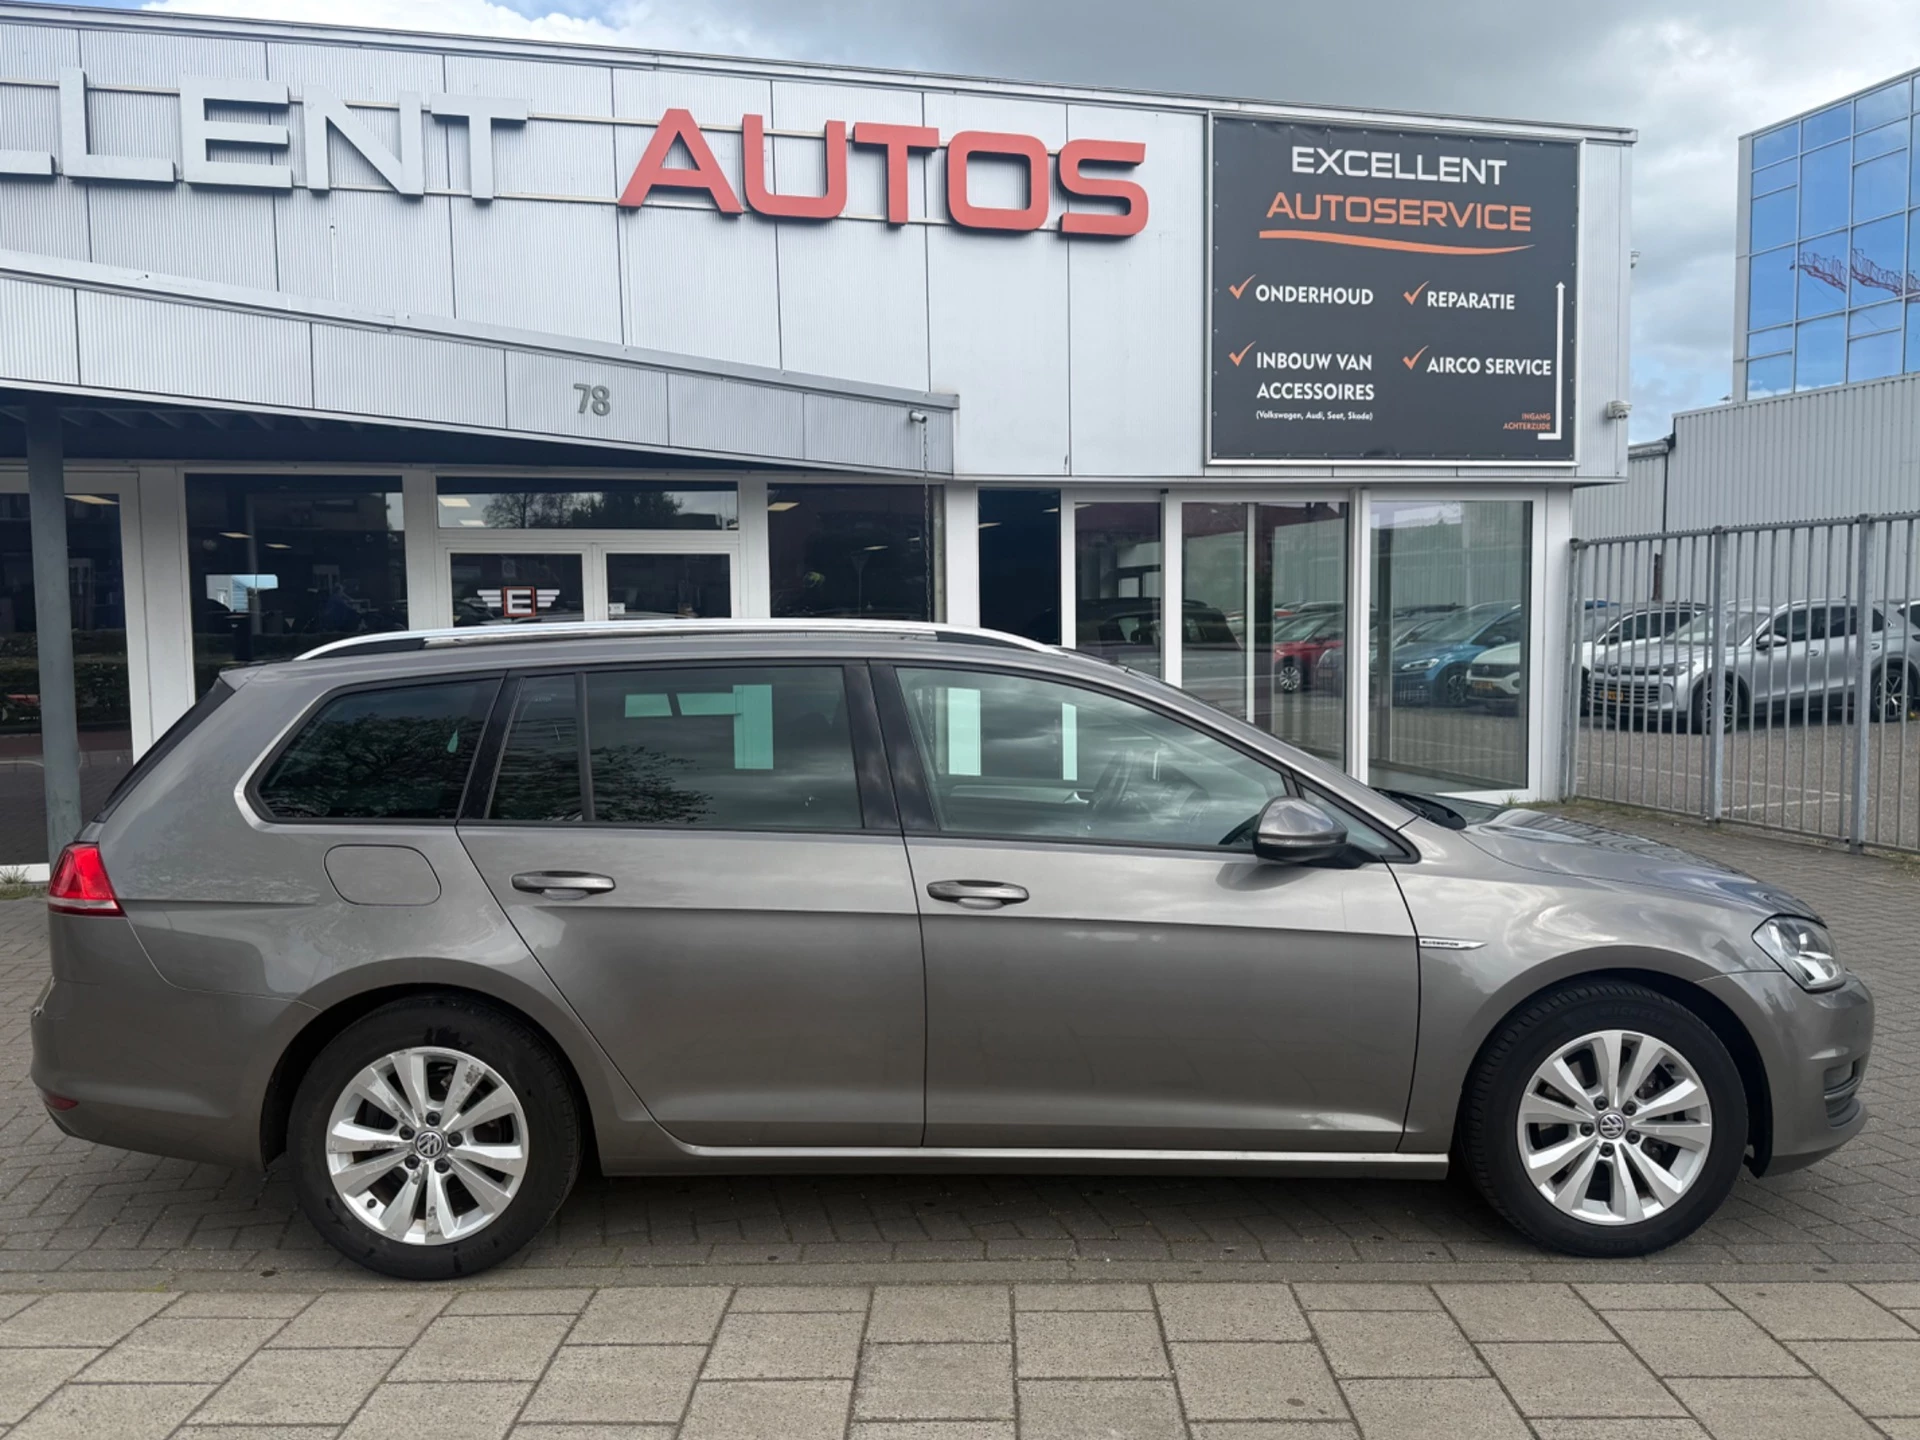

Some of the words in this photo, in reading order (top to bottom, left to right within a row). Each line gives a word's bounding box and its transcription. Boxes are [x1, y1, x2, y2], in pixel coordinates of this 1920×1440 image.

[618, 108, 1150, 237] AUTOS
[1291, 145, 1507, 186] EXCELLENT
[1266, 191, 1532, 233] AUTOSERVICE
[1255, 284, 1374, 305] ONDERHOUD
[1427, 290, 1516, 310] REPARATIE
[1256, 351, 1333, 370] INBOUW
[1336, 353, 1372, 371] VAN
[1426, 356, 1481, 374] AIRCO
[1485, 357, 1552, 376] SERVICE
[573, 382, 612, 417] 78
[1256, 381, 1375, 401] ACCESSOIRES
[1305, 411, 1326, 421] Audi,
